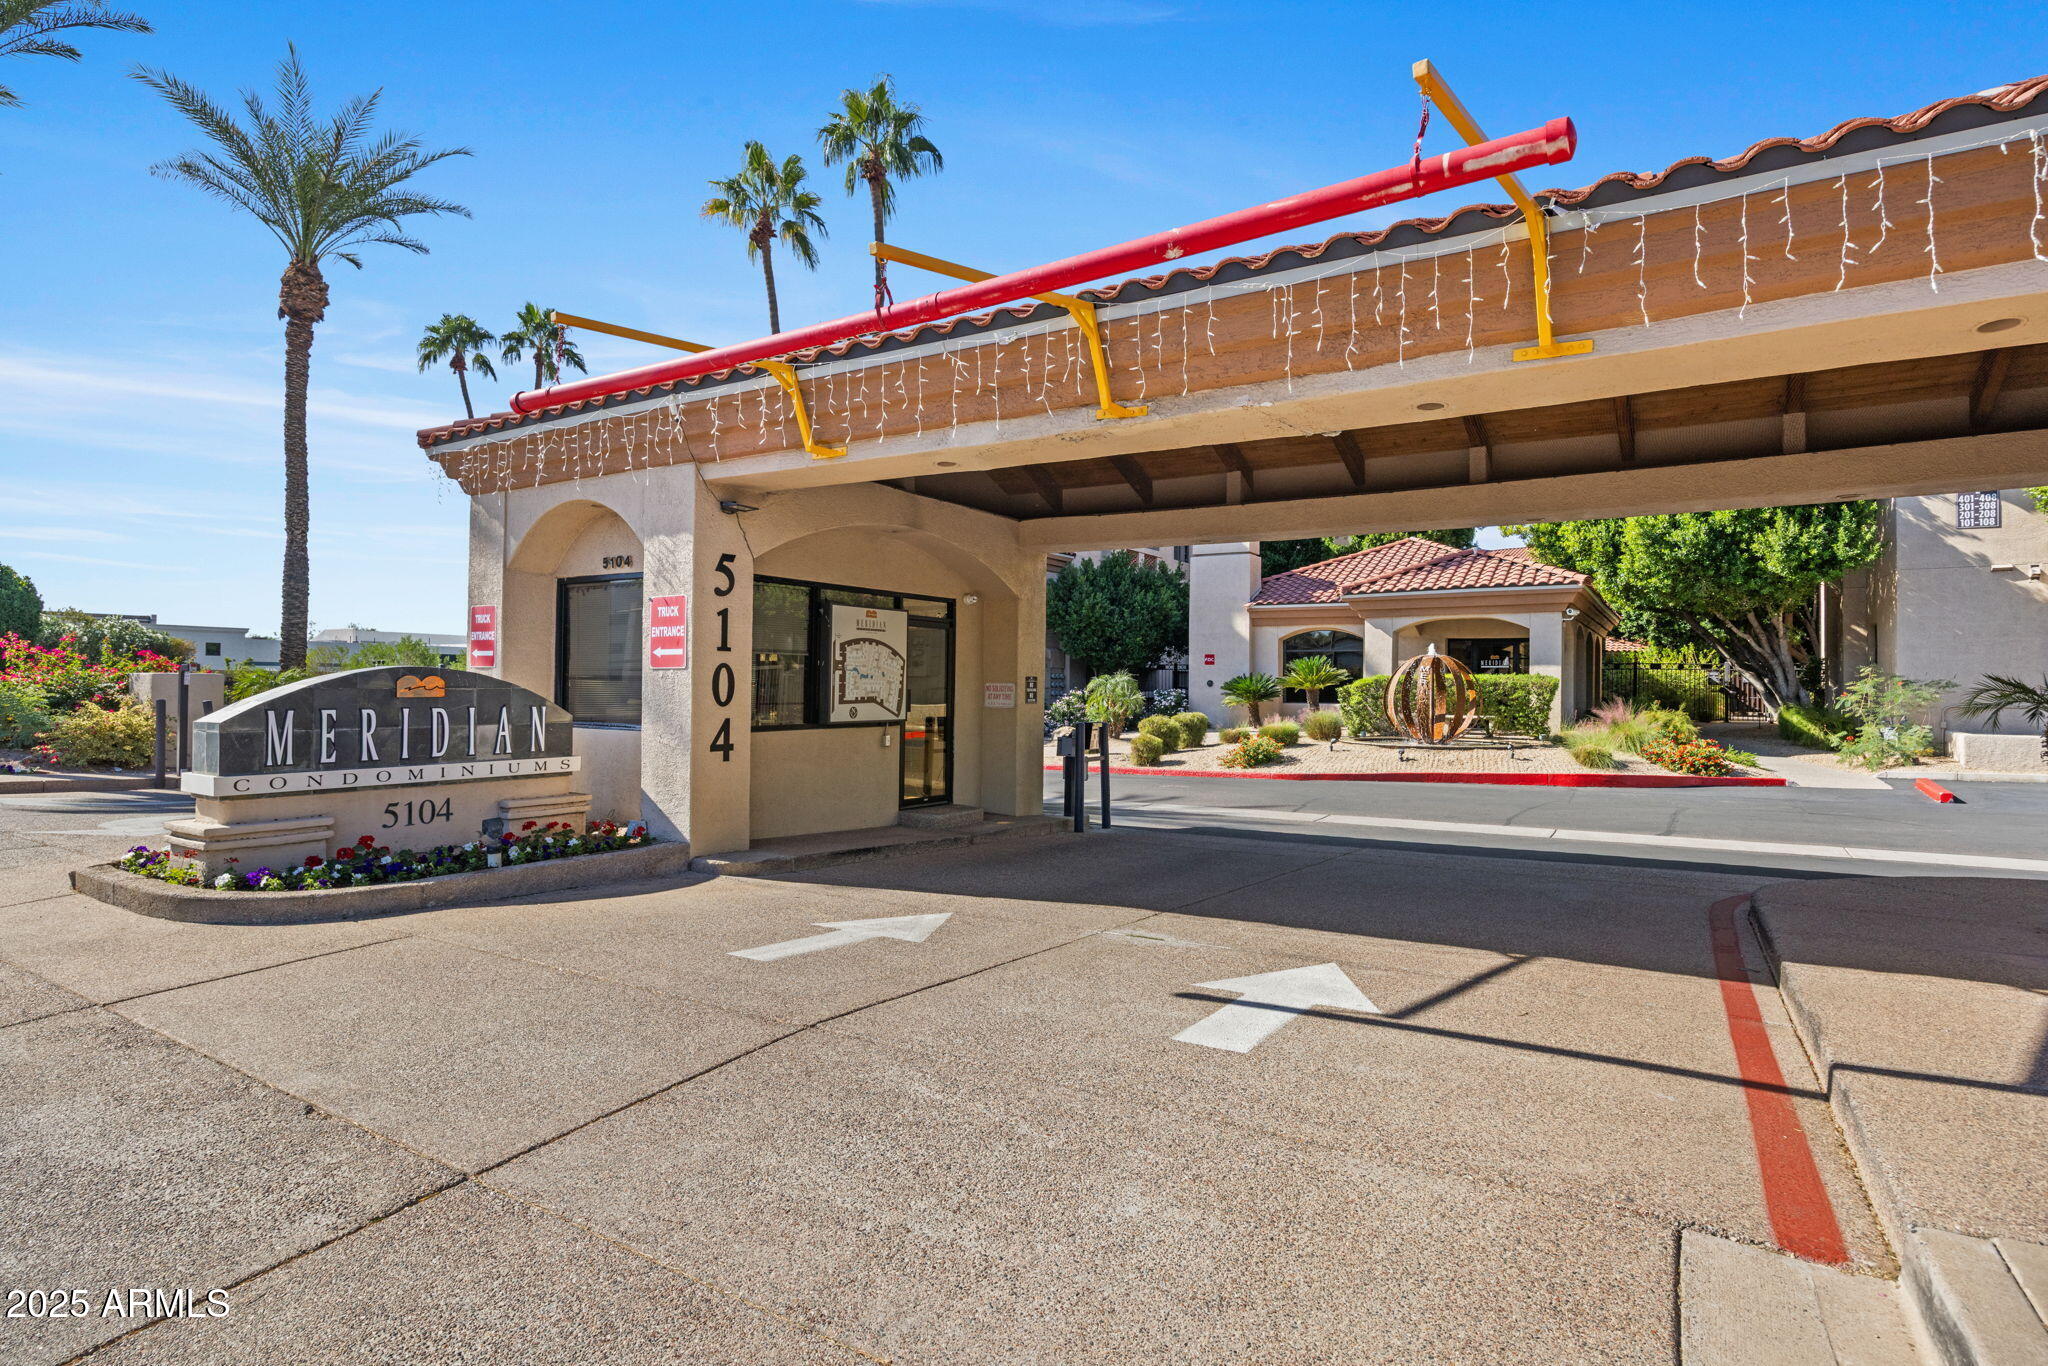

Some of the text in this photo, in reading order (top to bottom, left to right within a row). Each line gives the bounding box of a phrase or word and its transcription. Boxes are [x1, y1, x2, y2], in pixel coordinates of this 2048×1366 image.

[1958, 493, 1997, 503] 401-408
[1959, 501, 1996, 511] 301-308
[1959, 509, 1996, 519] 201-208
[1959, 517, 1996, 527] 101-108
[602, 555, 633, 569] 5104
[657, 605, 679, 617] TRUCK
[474, 613, 491, 624] TRUCK
[471, 630, 495, 641] ENTRANCE
[651, 625, 685, 638] ENTRANCE
[710, 553, 736, 762] 5104
[265, 705, 547, 766] MERIDIAN
[233, 759, 570, 792] CONDOMINIUMS
[381, 797, 454, 829] 5104
